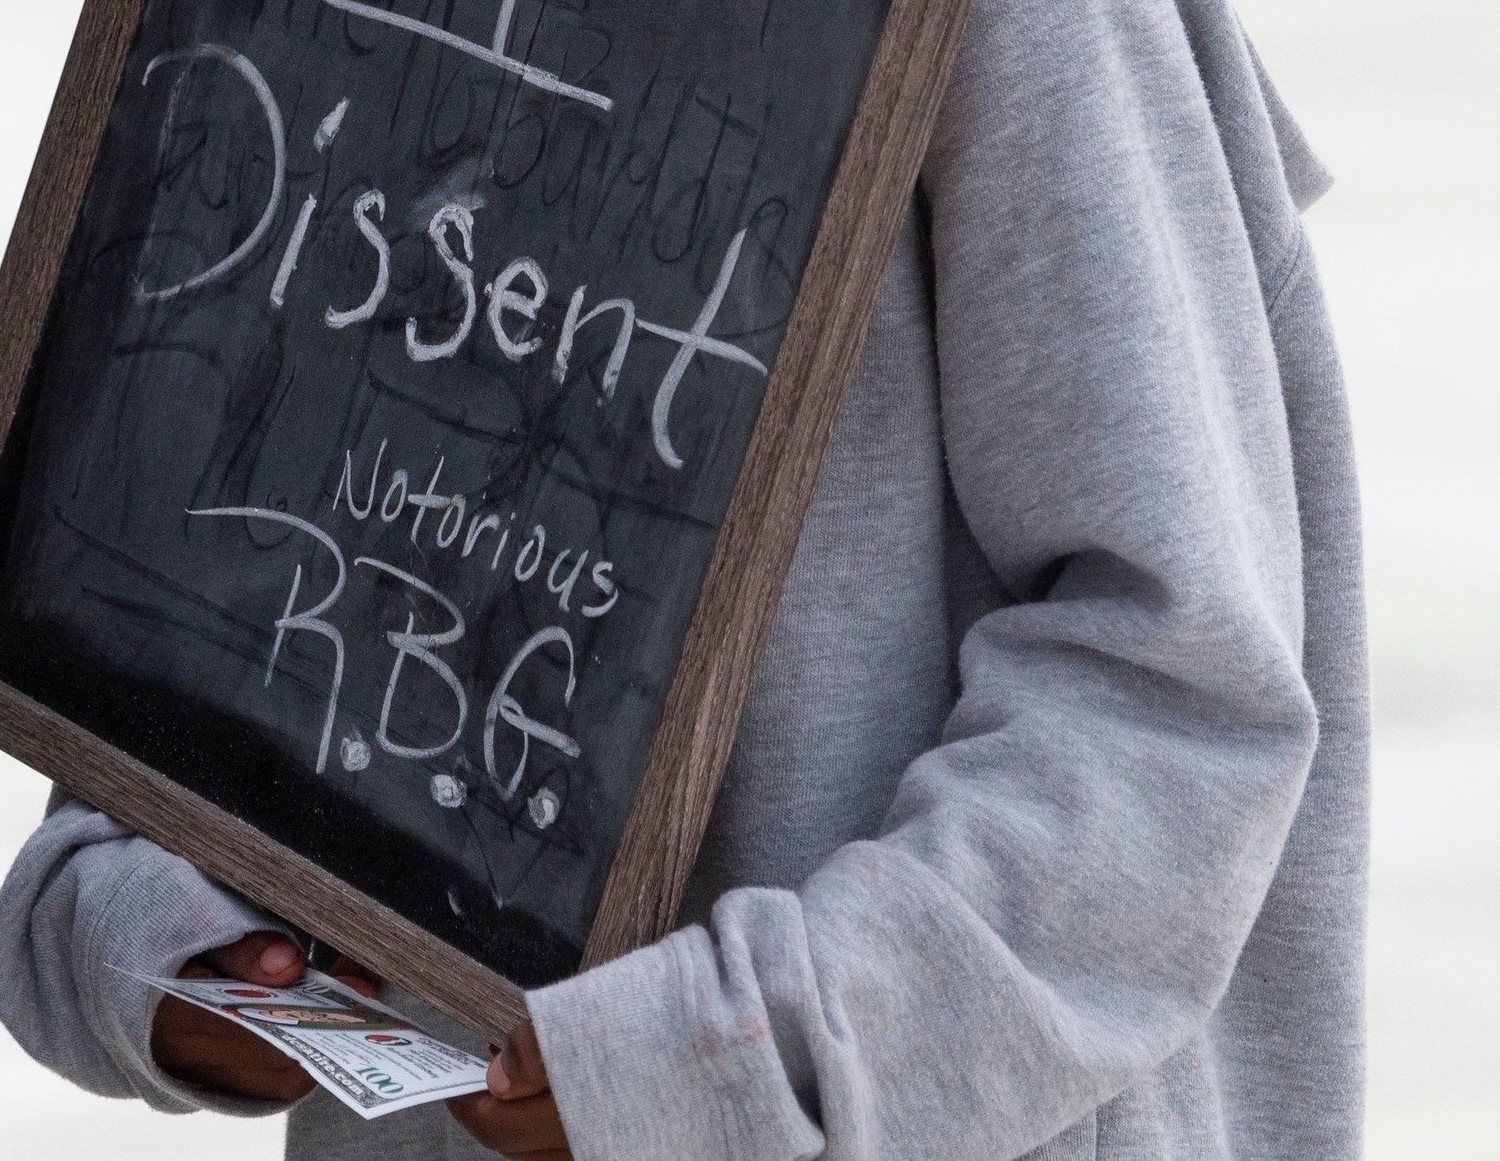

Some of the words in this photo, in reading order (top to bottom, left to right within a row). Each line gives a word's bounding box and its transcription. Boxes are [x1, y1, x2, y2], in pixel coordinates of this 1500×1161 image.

[141, 42, 768, 469] Dissent
[333, 438, 620, 617] Notorious
[353, 1066, 404, 1094] 100
